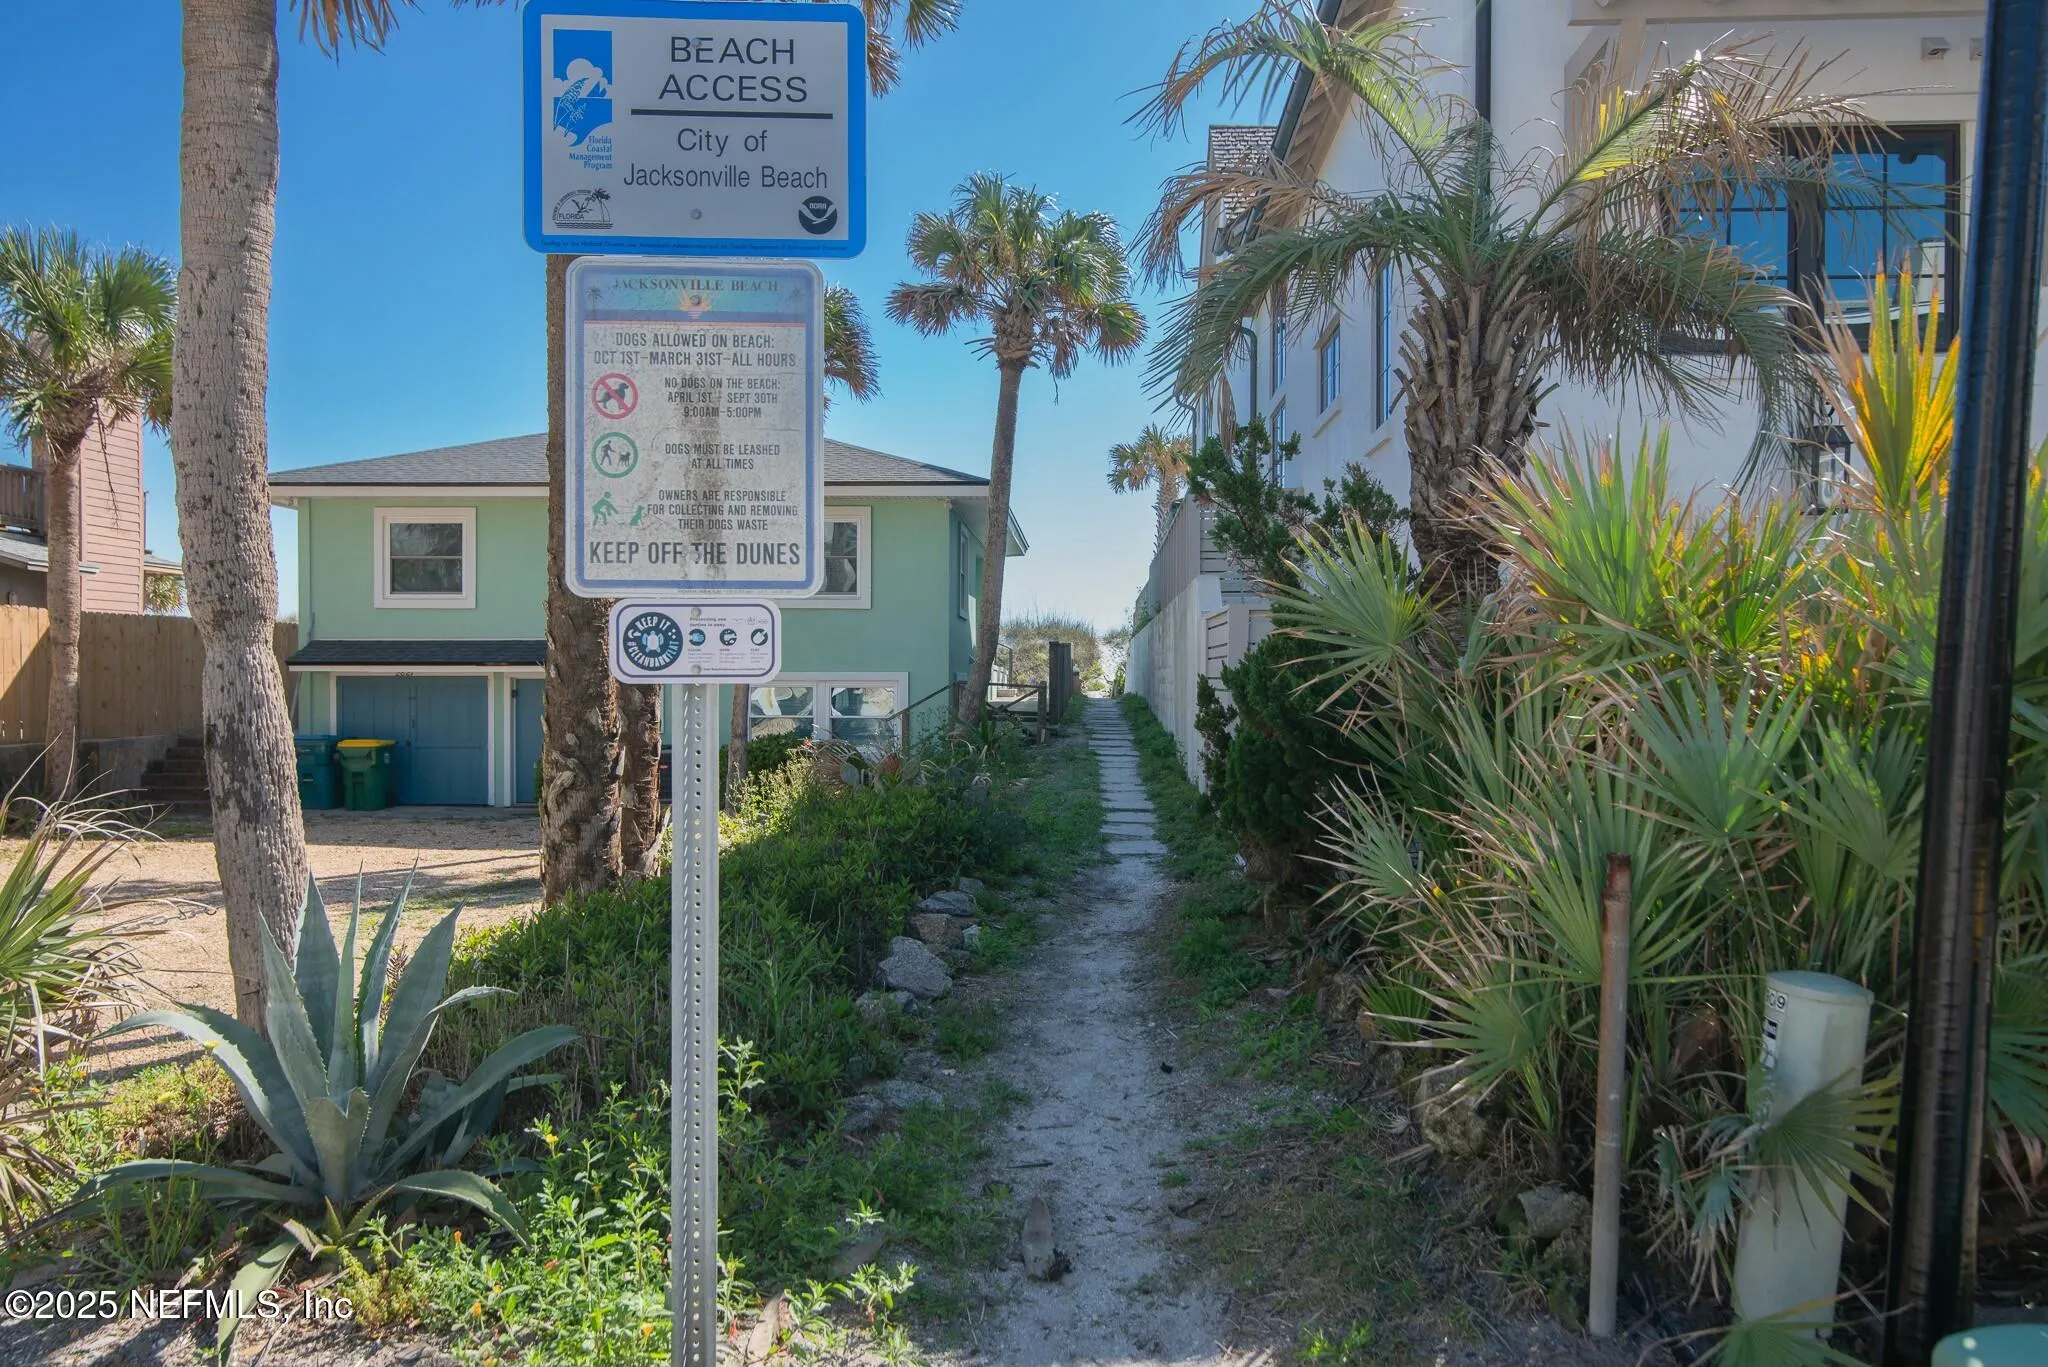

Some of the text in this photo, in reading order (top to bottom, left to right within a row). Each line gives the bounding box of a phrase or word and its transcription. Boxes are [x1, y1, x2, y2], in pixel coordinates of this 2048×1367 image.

[670, 36, 795, 65] BEACH
[658, 74, 808, 103] ACCESS
[588, 135, 612, 144] Florida
[677, 128, 768, 157] City of
[586, 144, 612, 152] Coastal
[568, 153, 612, 161] Management
[584, 161, 613, 170] Program
[623, 163, 828, 189] Jacksonville Beach
[614, 279, 778, 292] JACKSONVILLE BEACH
[615, 333, 775, 349] DOGS ALLOWED ON BEACH:
[594, 351, 617, 365] OCT
[757, 353, 796, 367] HOURS
[664, 377, 781, 390] NO DOGS ON THE BEACH:
[667, 392, 694, 403] APRIL
[698, 392, 712, 403] 1ST
[727, 392, 751, 404] SEPT
[754, 392, 778, 404] 30TH
[665, 443, 781, 456] DOGS MUST BE LEASHED
[691, 458, 754, 470] AT ALL TIMES
[658, 489, 787, 502] OWNERS ARE RESPONSIBLE
[647, 504, 798, 516] FOR COLLECTING AND REMOVING
[678, 518, 768, 531] THEIR DOGS WASTE
[589, 541, 800, 565] KEEP OFF THE DUNES
[635, 616, 672, 631] KEEP IT
